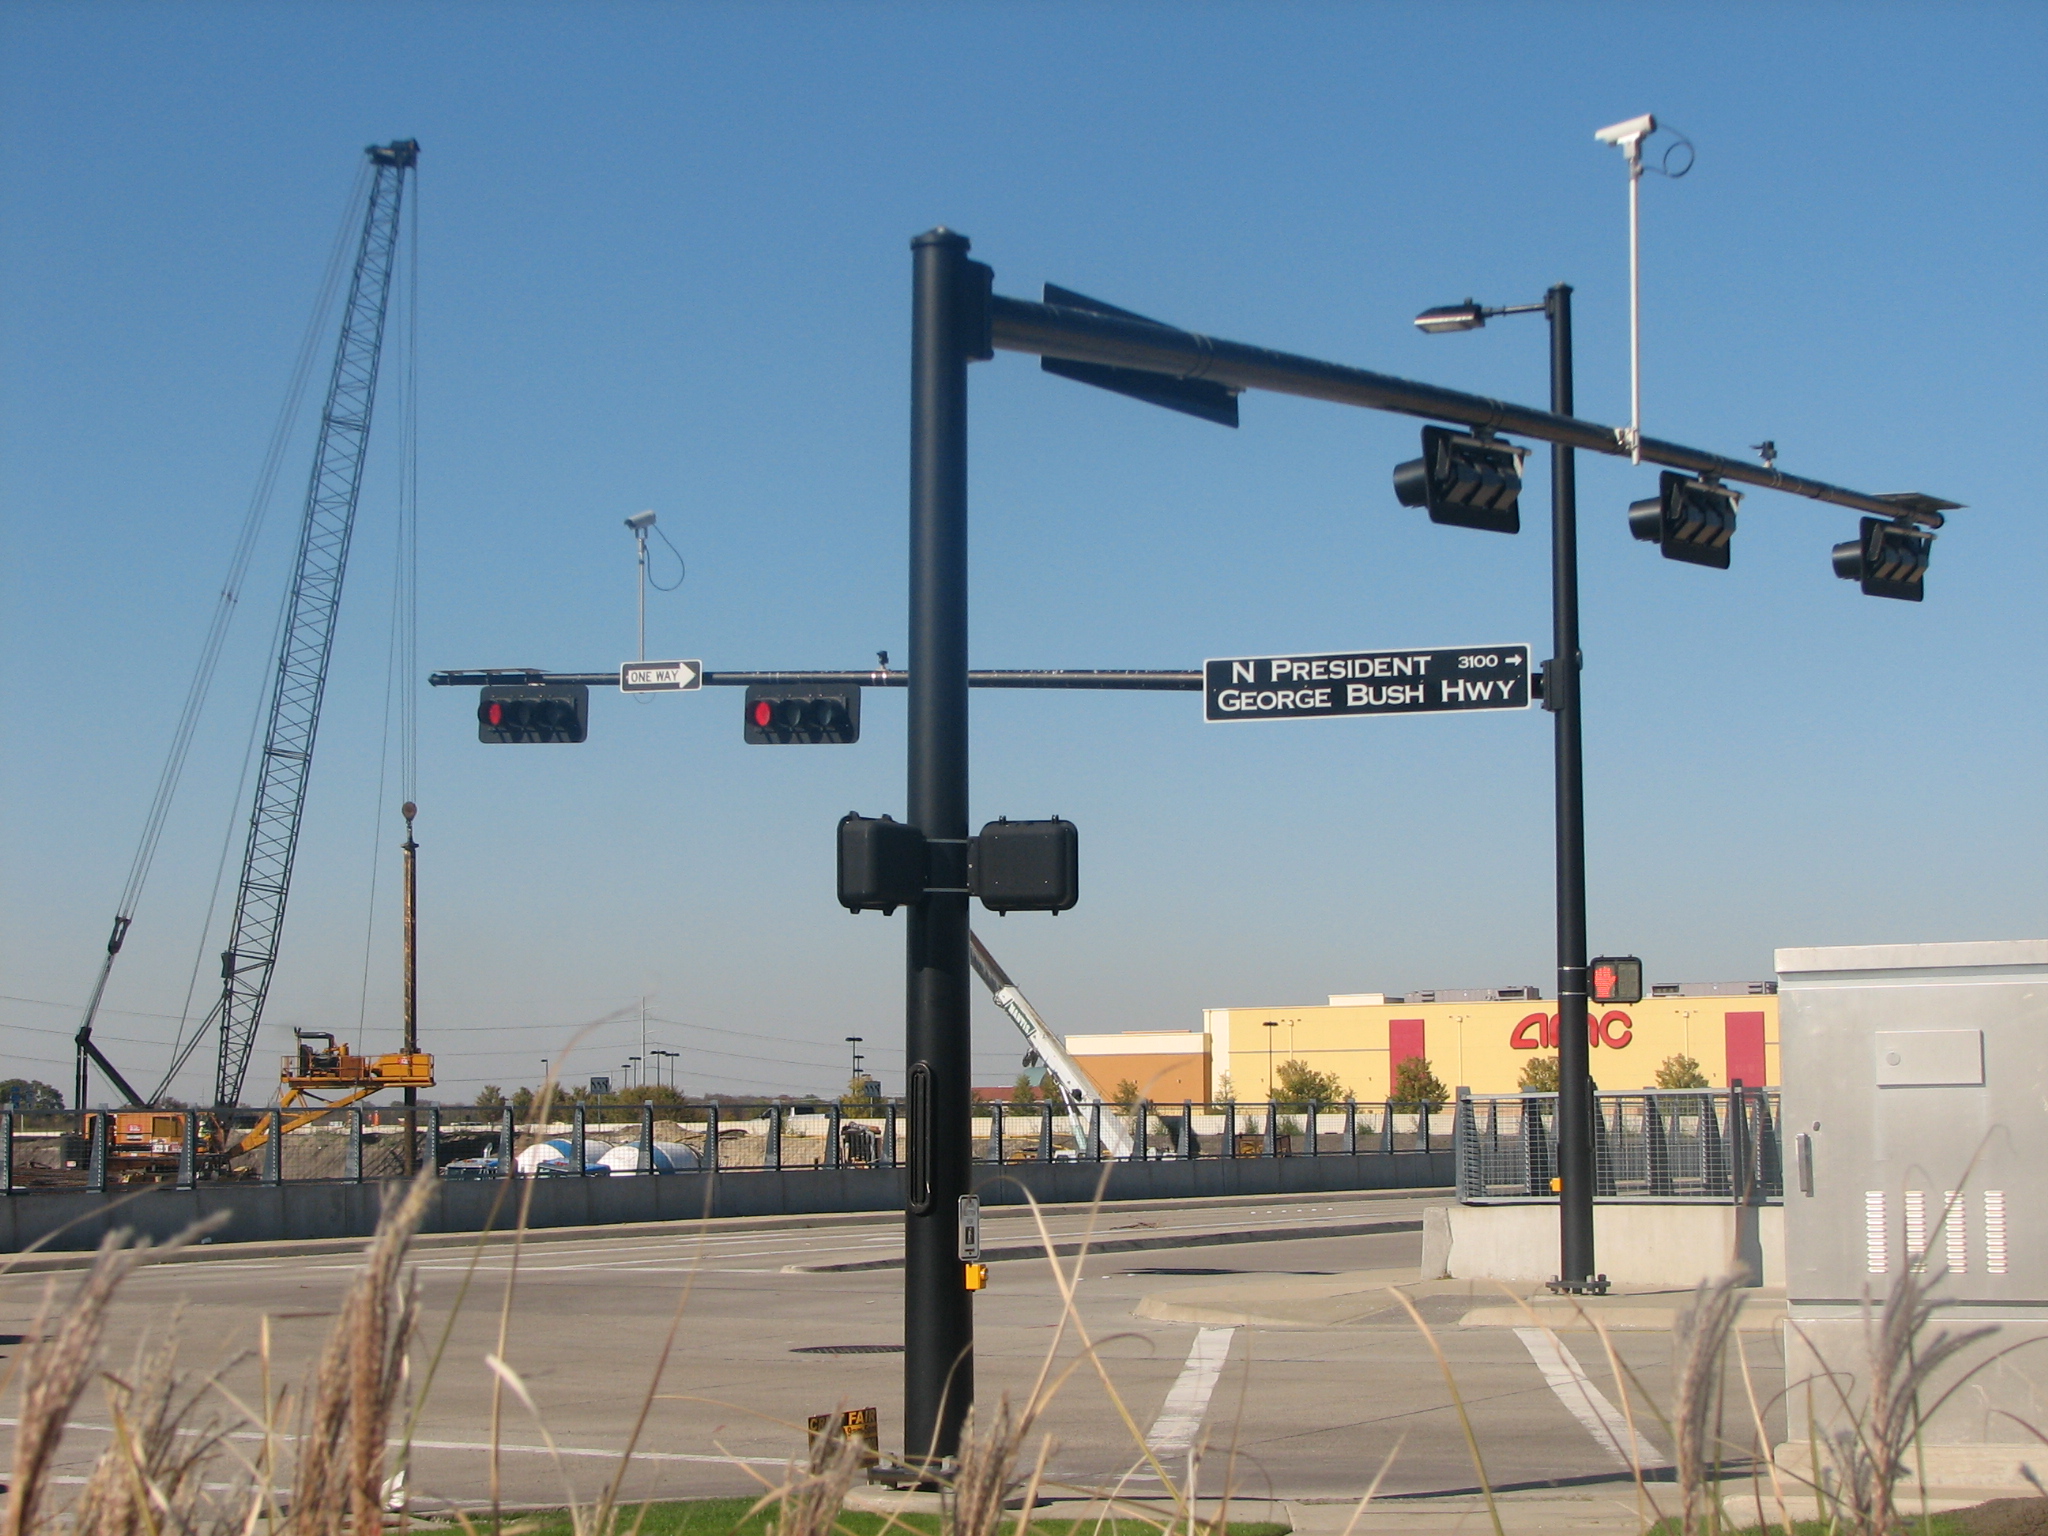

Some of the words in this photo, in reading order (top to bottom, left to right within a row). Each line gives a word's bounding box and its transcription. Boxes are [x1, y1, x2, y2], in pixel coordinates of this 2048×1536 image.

[1231, 660, 1255, 684] N
[1270, 655, 1432, 683] PRESIDENT
[1457, 653, 1499, 670] 3100
[630, 671, 652, 683] ONE
[655, 669, 679, 682] WAY
[1217, 687, 1332, 712] GEORGE
[1346, 679, 1425, 707] BUSH
[1441, 678, 1517, 703] HWY
[847, 1408, 875, 1425] FAIR
